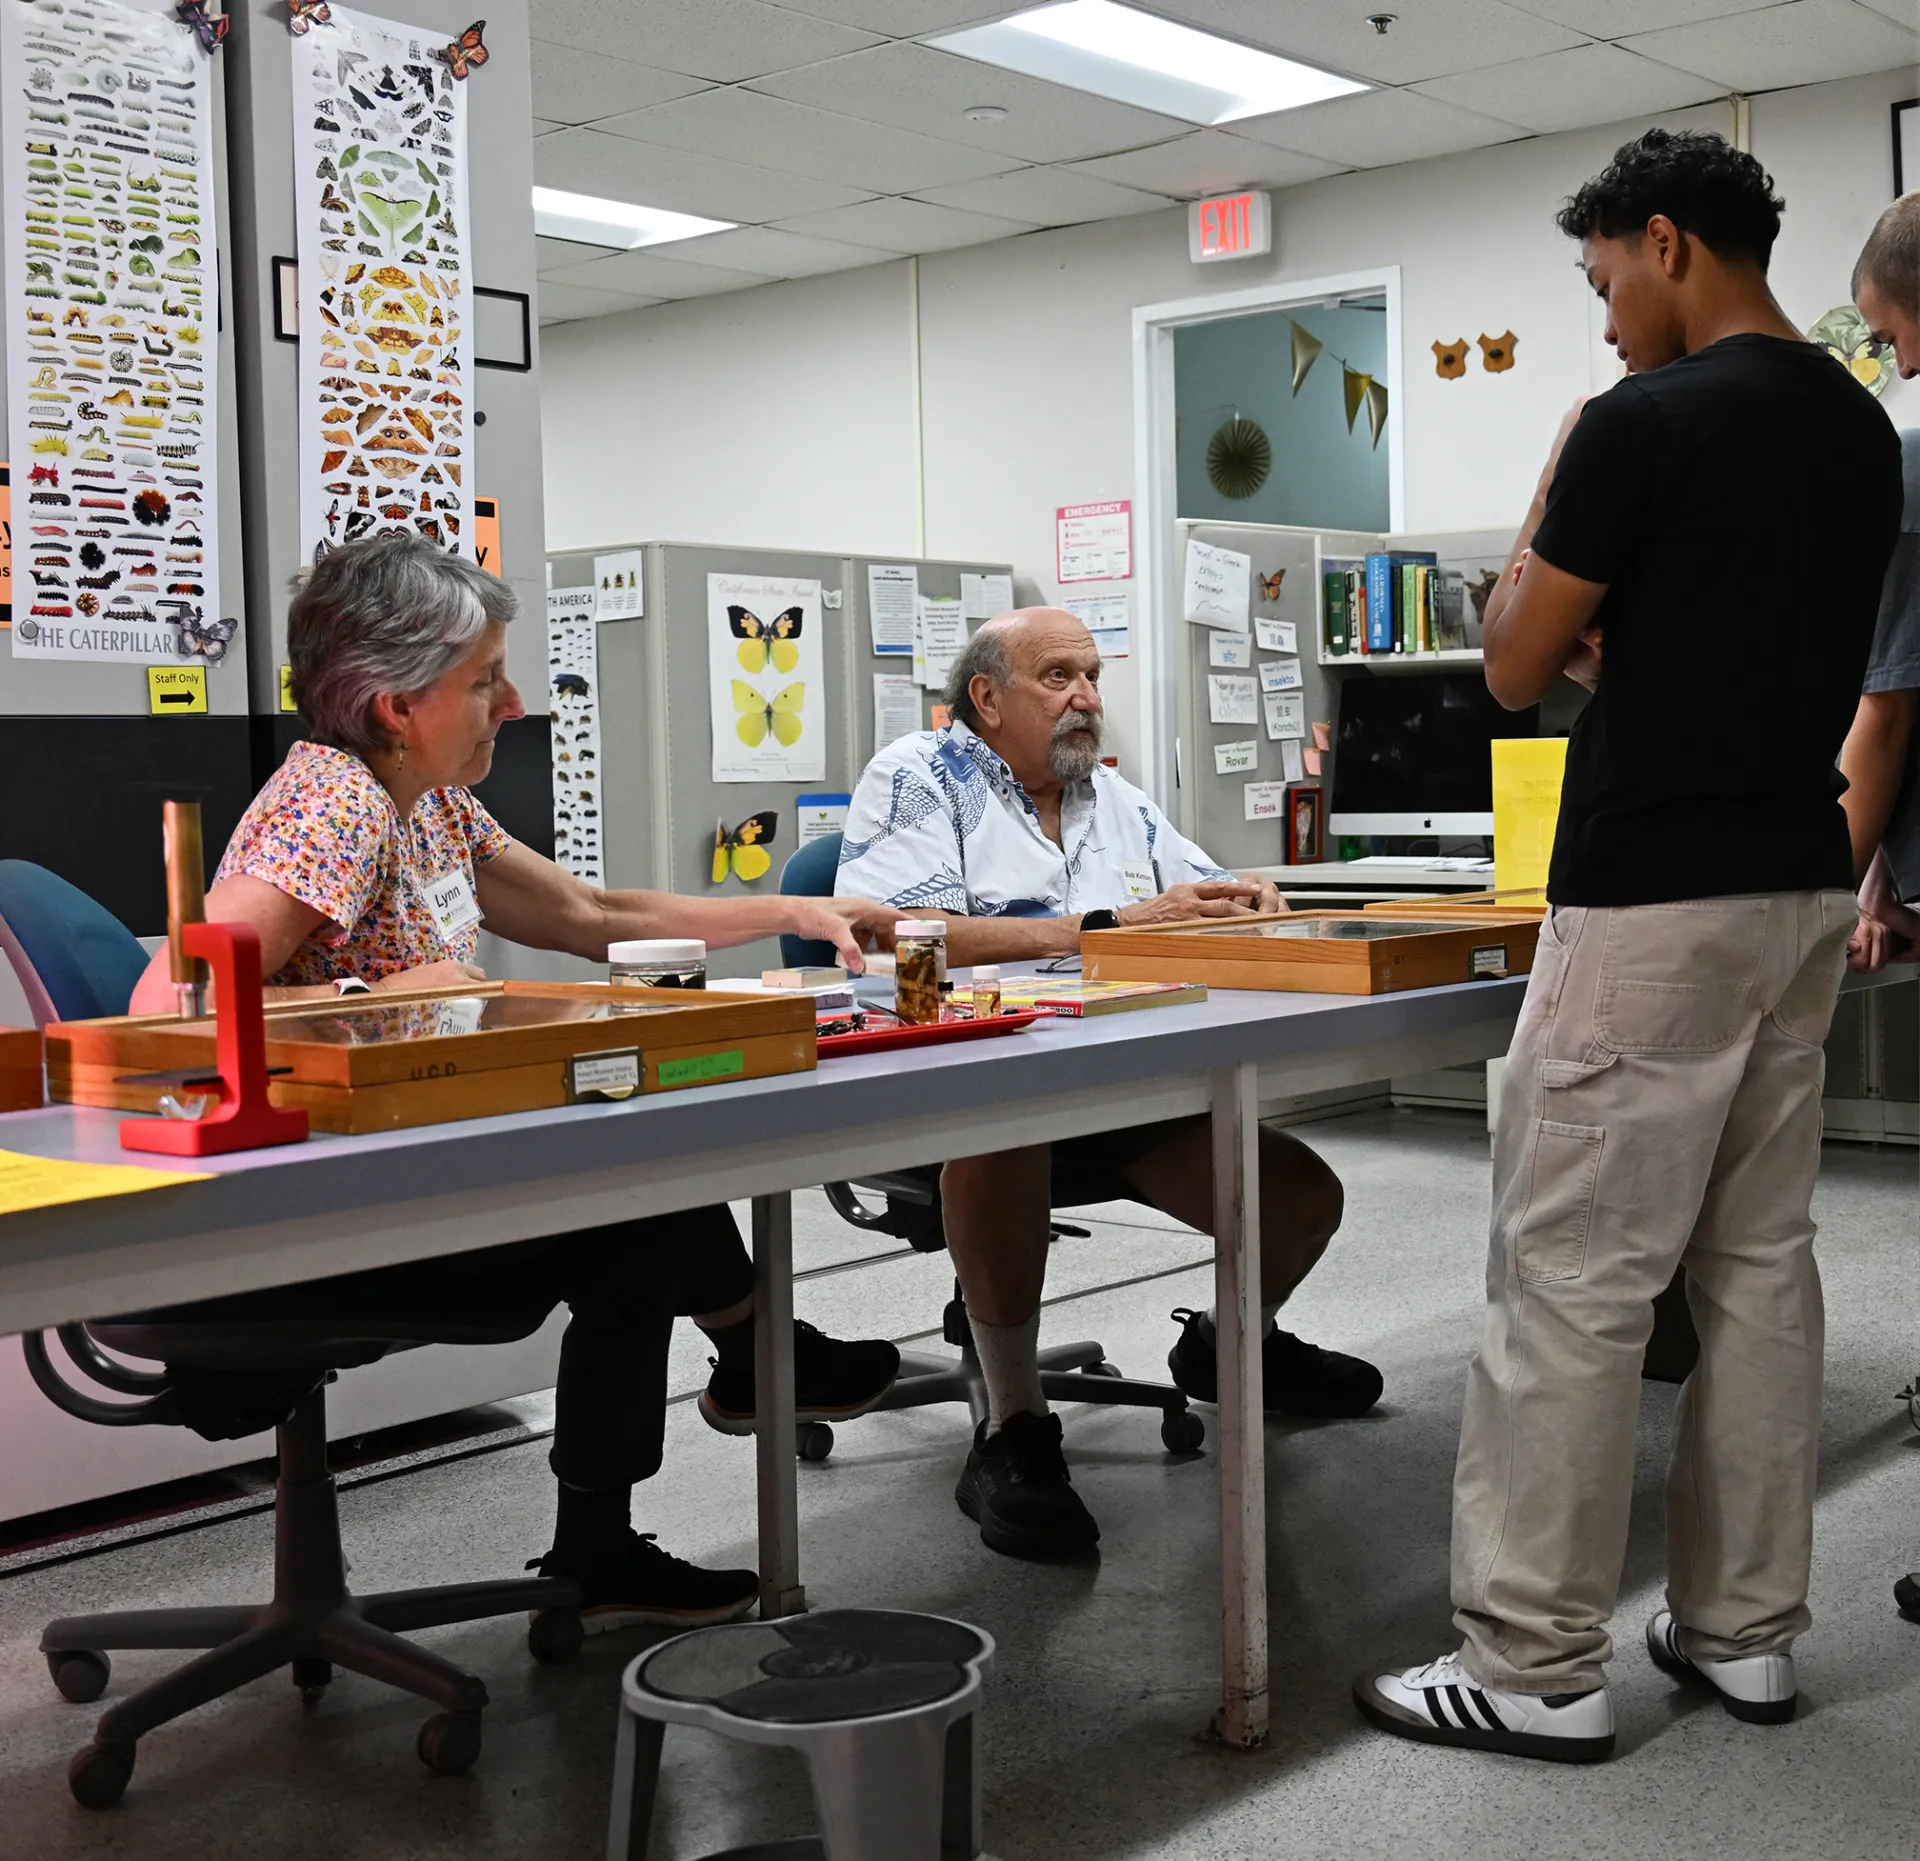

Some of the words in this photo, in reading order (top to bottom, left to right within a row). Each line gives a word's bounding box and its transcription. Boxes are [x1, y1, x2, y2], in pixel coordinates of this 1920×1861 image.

[1199, 195, 1253, 257] EXIT
[1064, 503, 1122, 518] EMERGENCY
[559, 594, 593, 607] AMERICA
[33, 627, 64, 649] THE
[70, 628, 173, 654] CATERPILLAR
[155, 673, 177, 684] Staff
[179, 673, 199, 685] Only
[1267, 676, 1295, 688] insekto
[1225, 756, 1249, 767] Rovar
[1125, 870, 1135, 879] Bob
[434, 886, 461, 908] Lynn
